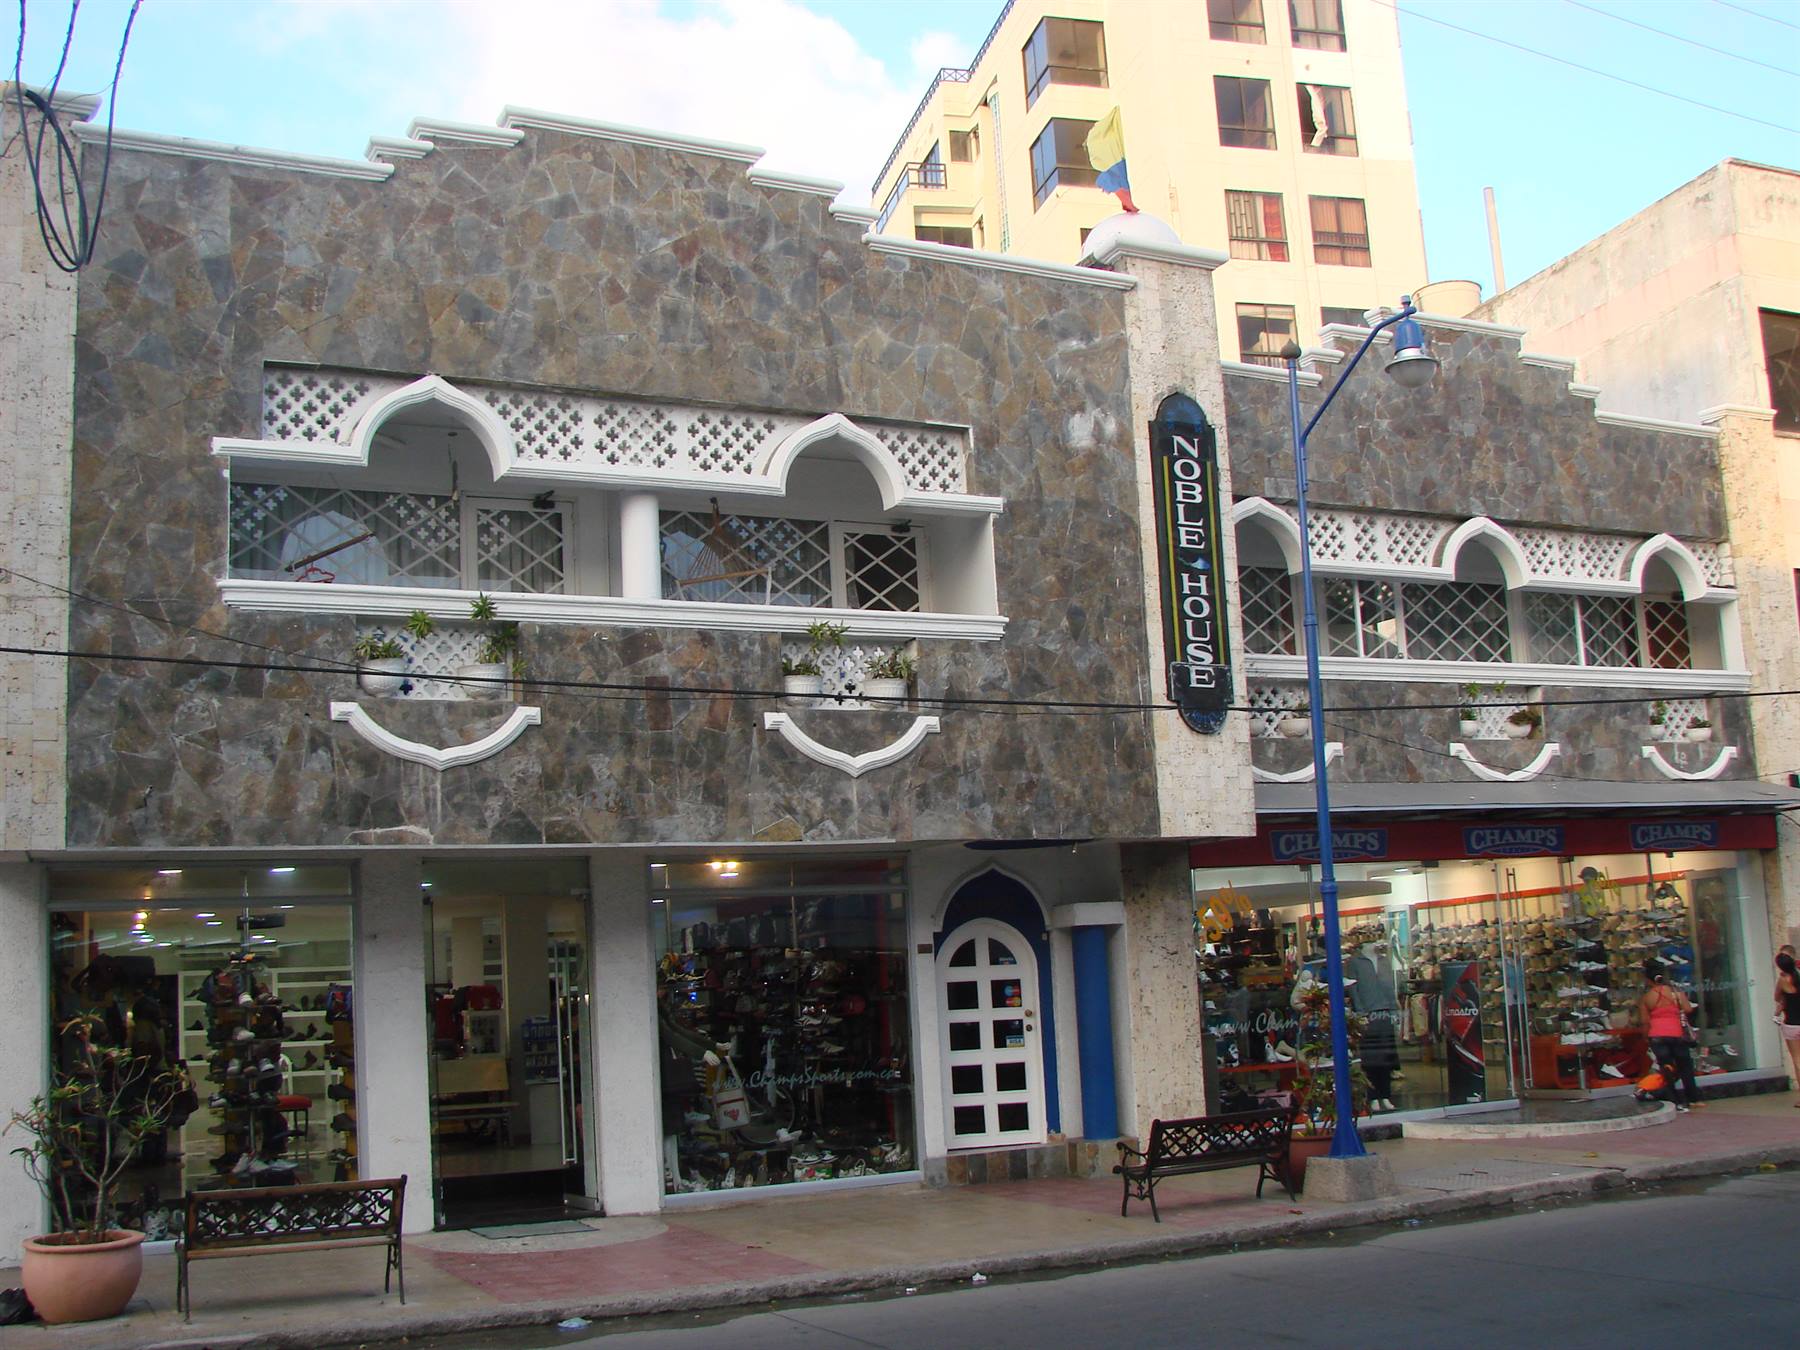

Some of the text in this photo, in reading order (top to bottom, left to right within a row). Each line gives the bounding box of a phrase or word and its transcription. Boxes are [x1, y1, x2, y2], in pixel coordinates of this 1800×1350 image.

[1171, 435, 1216, 689] NOBLE HOUSE
[1279, 831, 1380, 855] CHMPS
[1470, 827, 1558, 850] CHAMPS
[1635, 823, 1713, 845] CHAMPS
